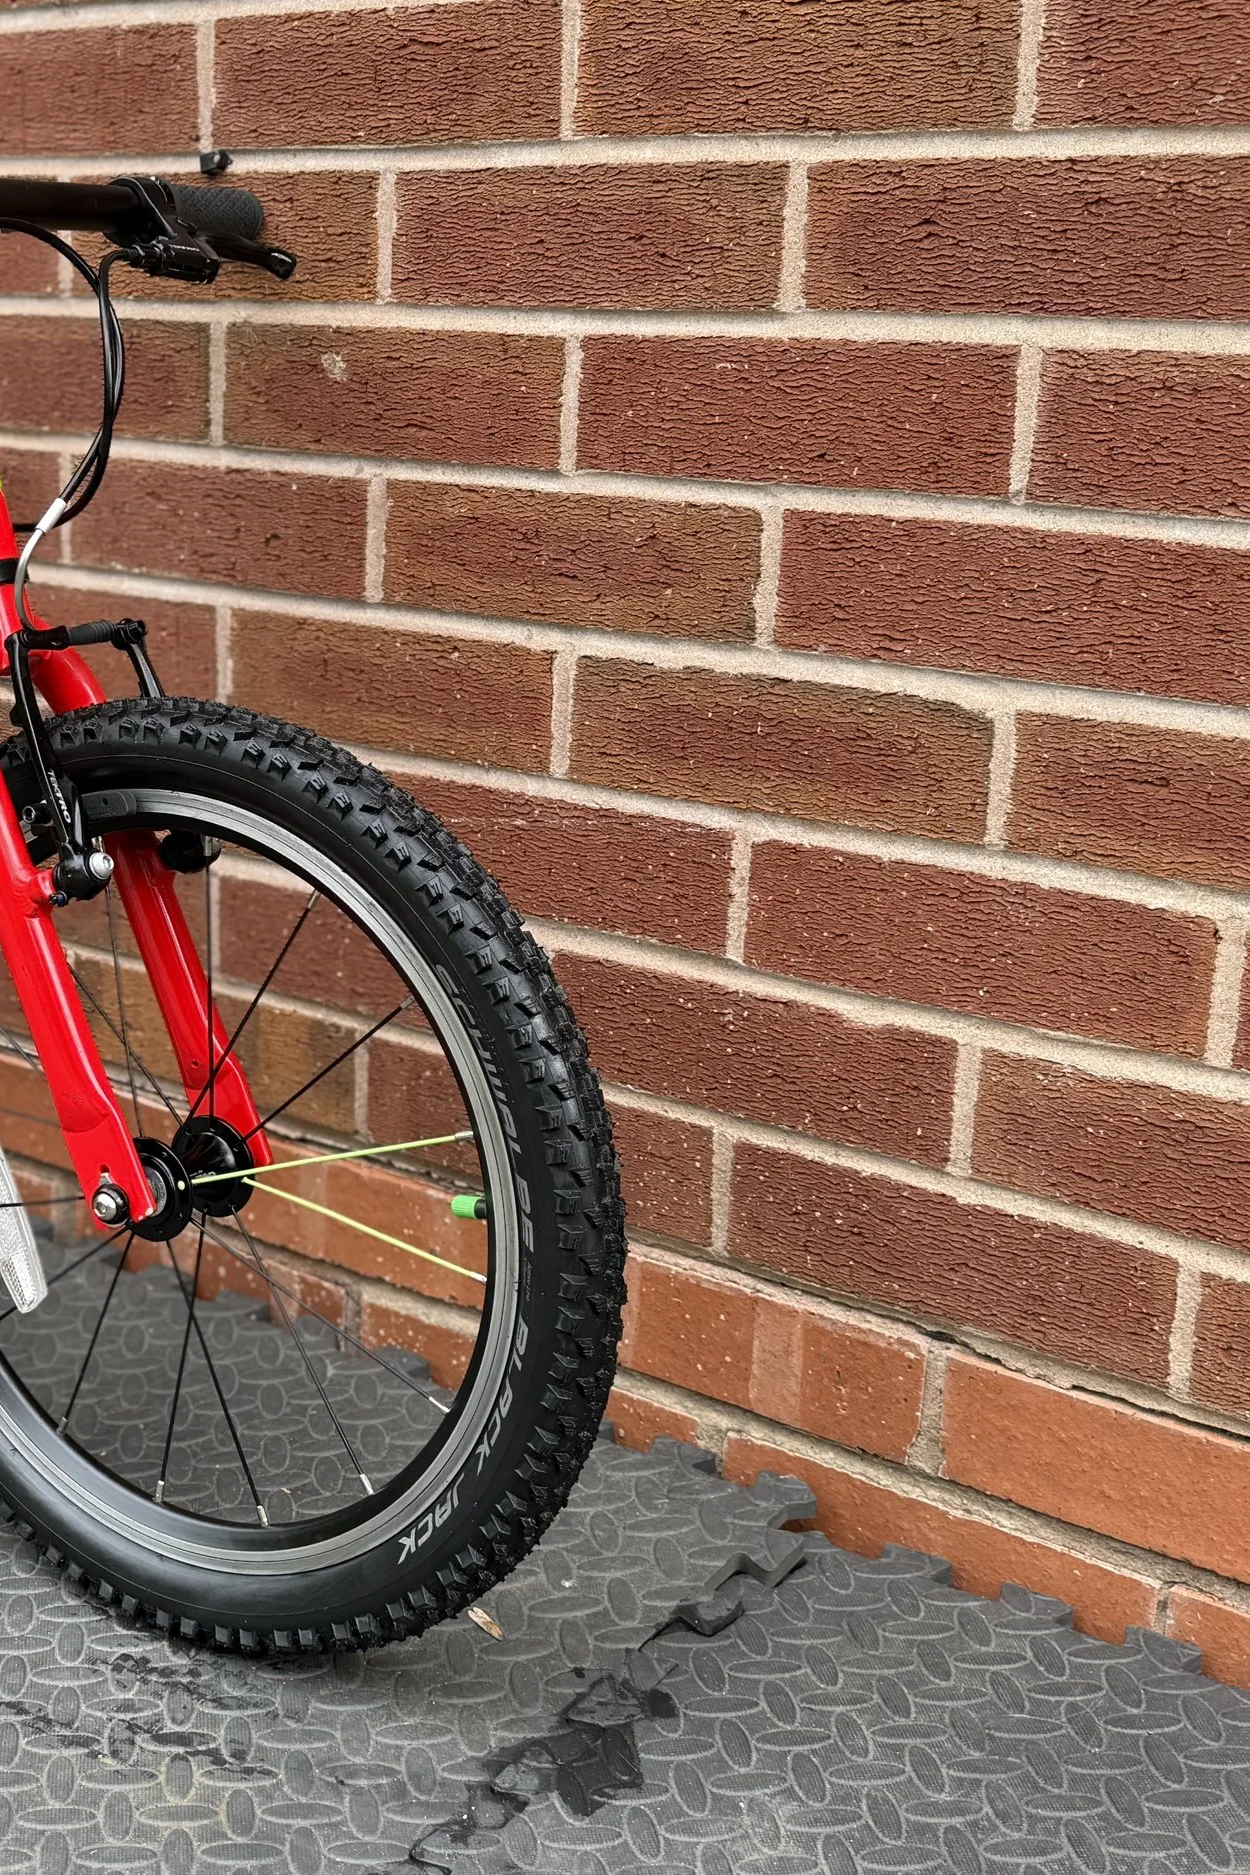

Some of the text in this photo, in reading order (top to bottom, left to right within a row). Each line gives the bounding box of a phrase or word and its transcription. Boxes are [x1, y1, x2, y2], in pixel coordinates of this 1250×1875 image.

[47, 769, 72, 824] TEKTRO
[435, 963, 535, 1253] SCHWALBE
[476, 1312, 529, 1477] BLACK
[397, 1471, 466, 1566] JACK
